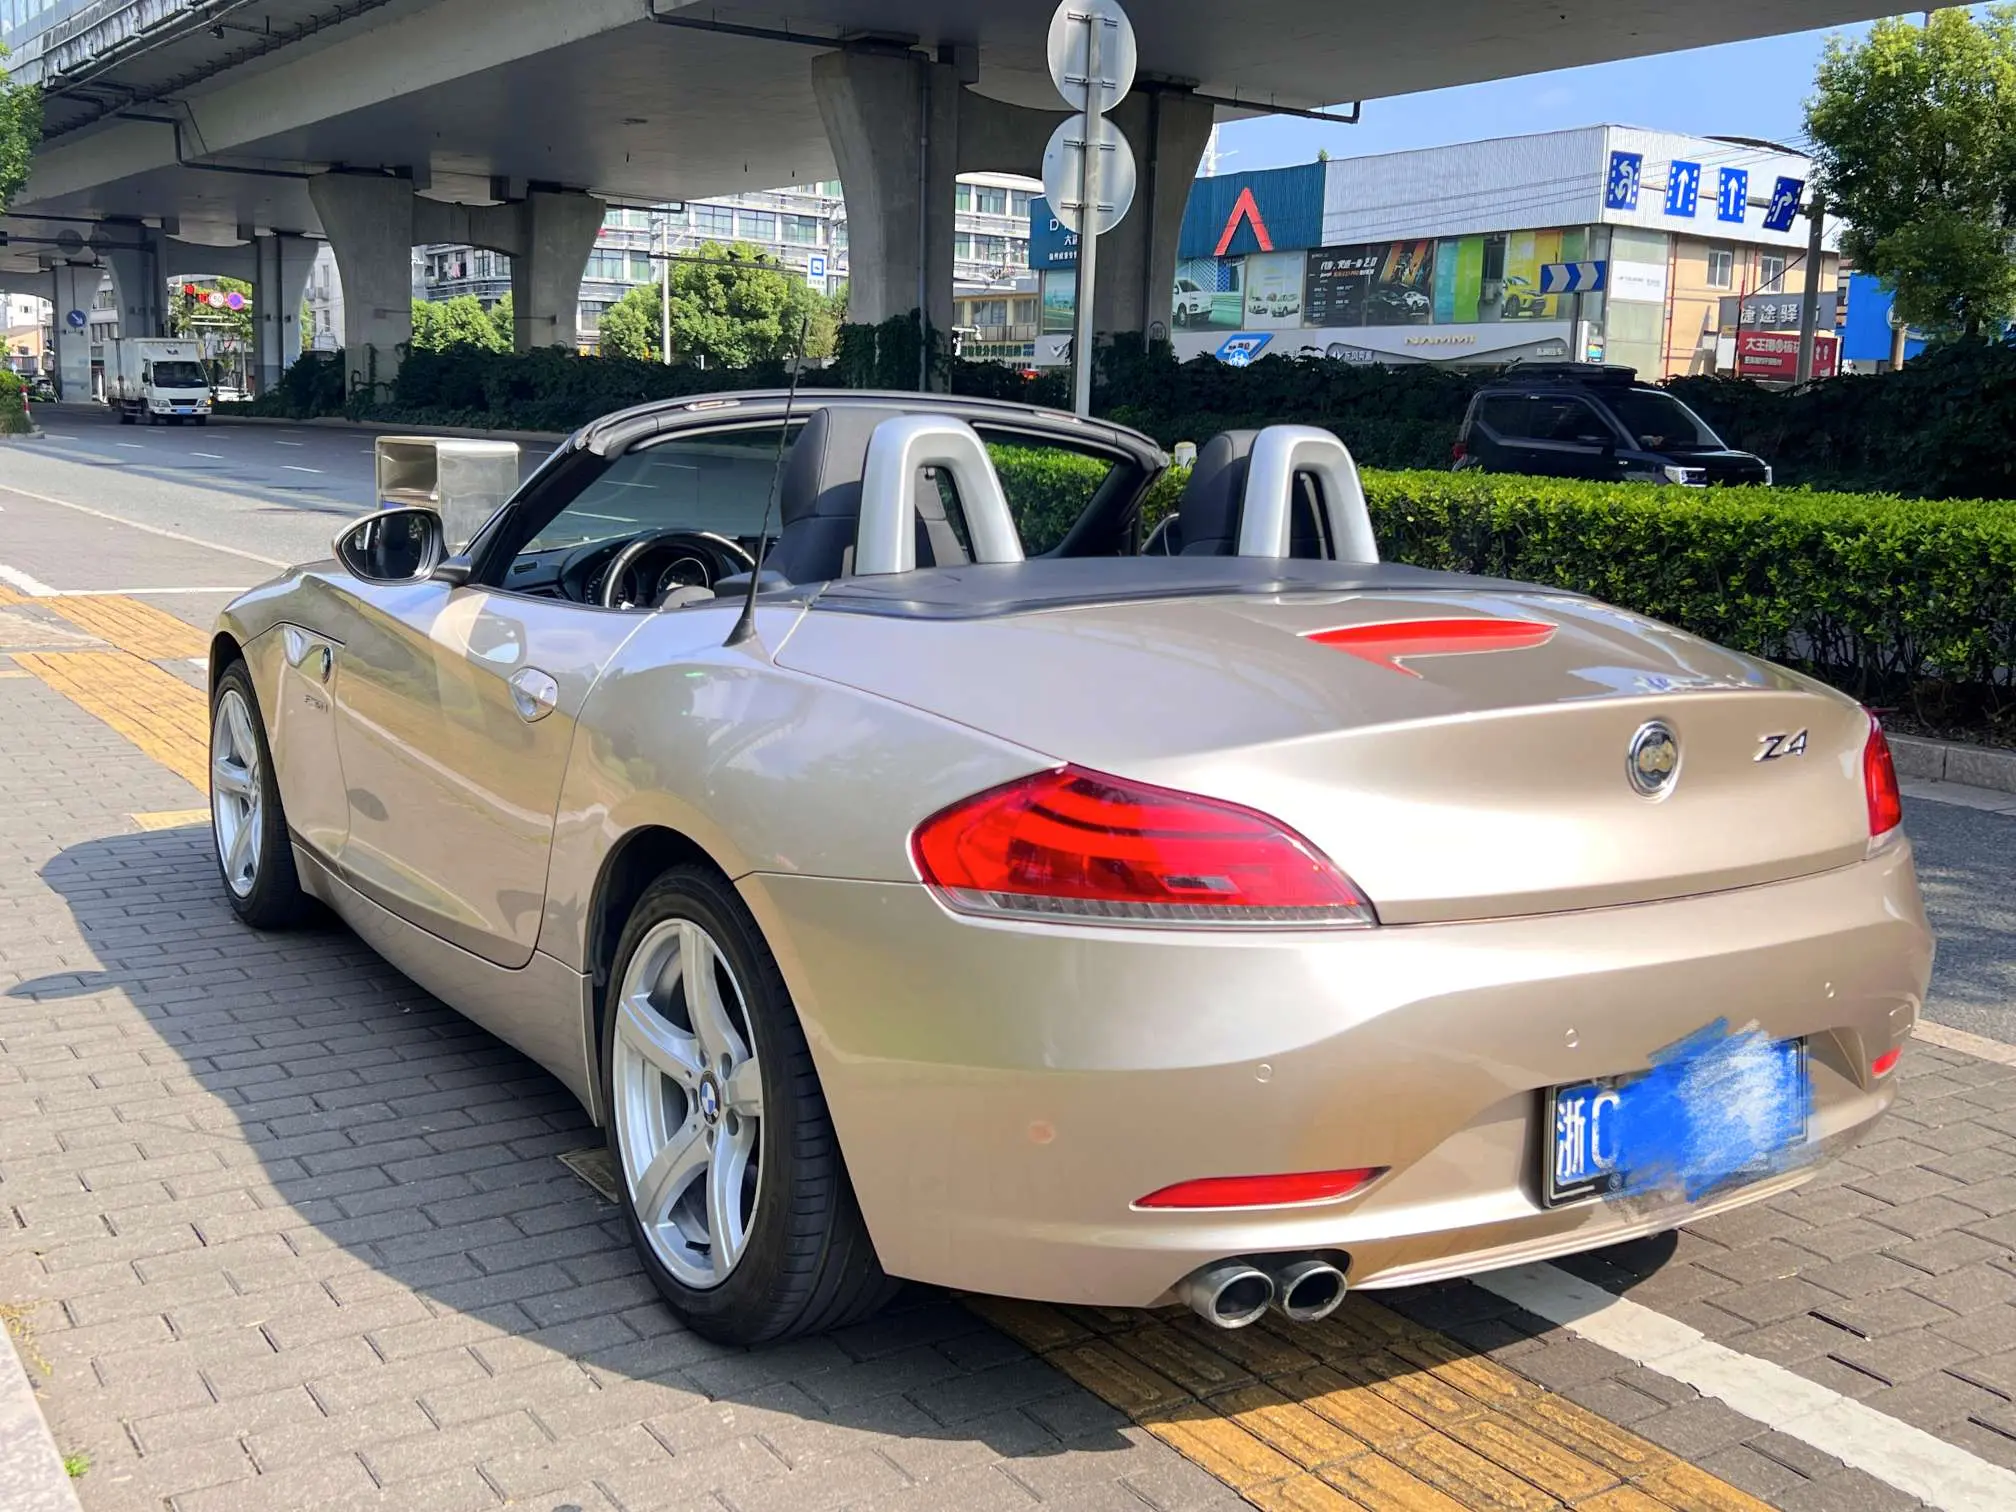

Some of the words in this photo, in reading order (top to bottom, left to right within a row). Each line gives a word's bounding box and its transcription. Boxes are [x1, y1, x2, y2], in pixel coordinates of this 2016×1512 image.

[1740, 303, 1821, 324] 捷途驿
[1405, 335, 1476, 346] NAMMI
[1753, 728, 1808, 762] Z4
